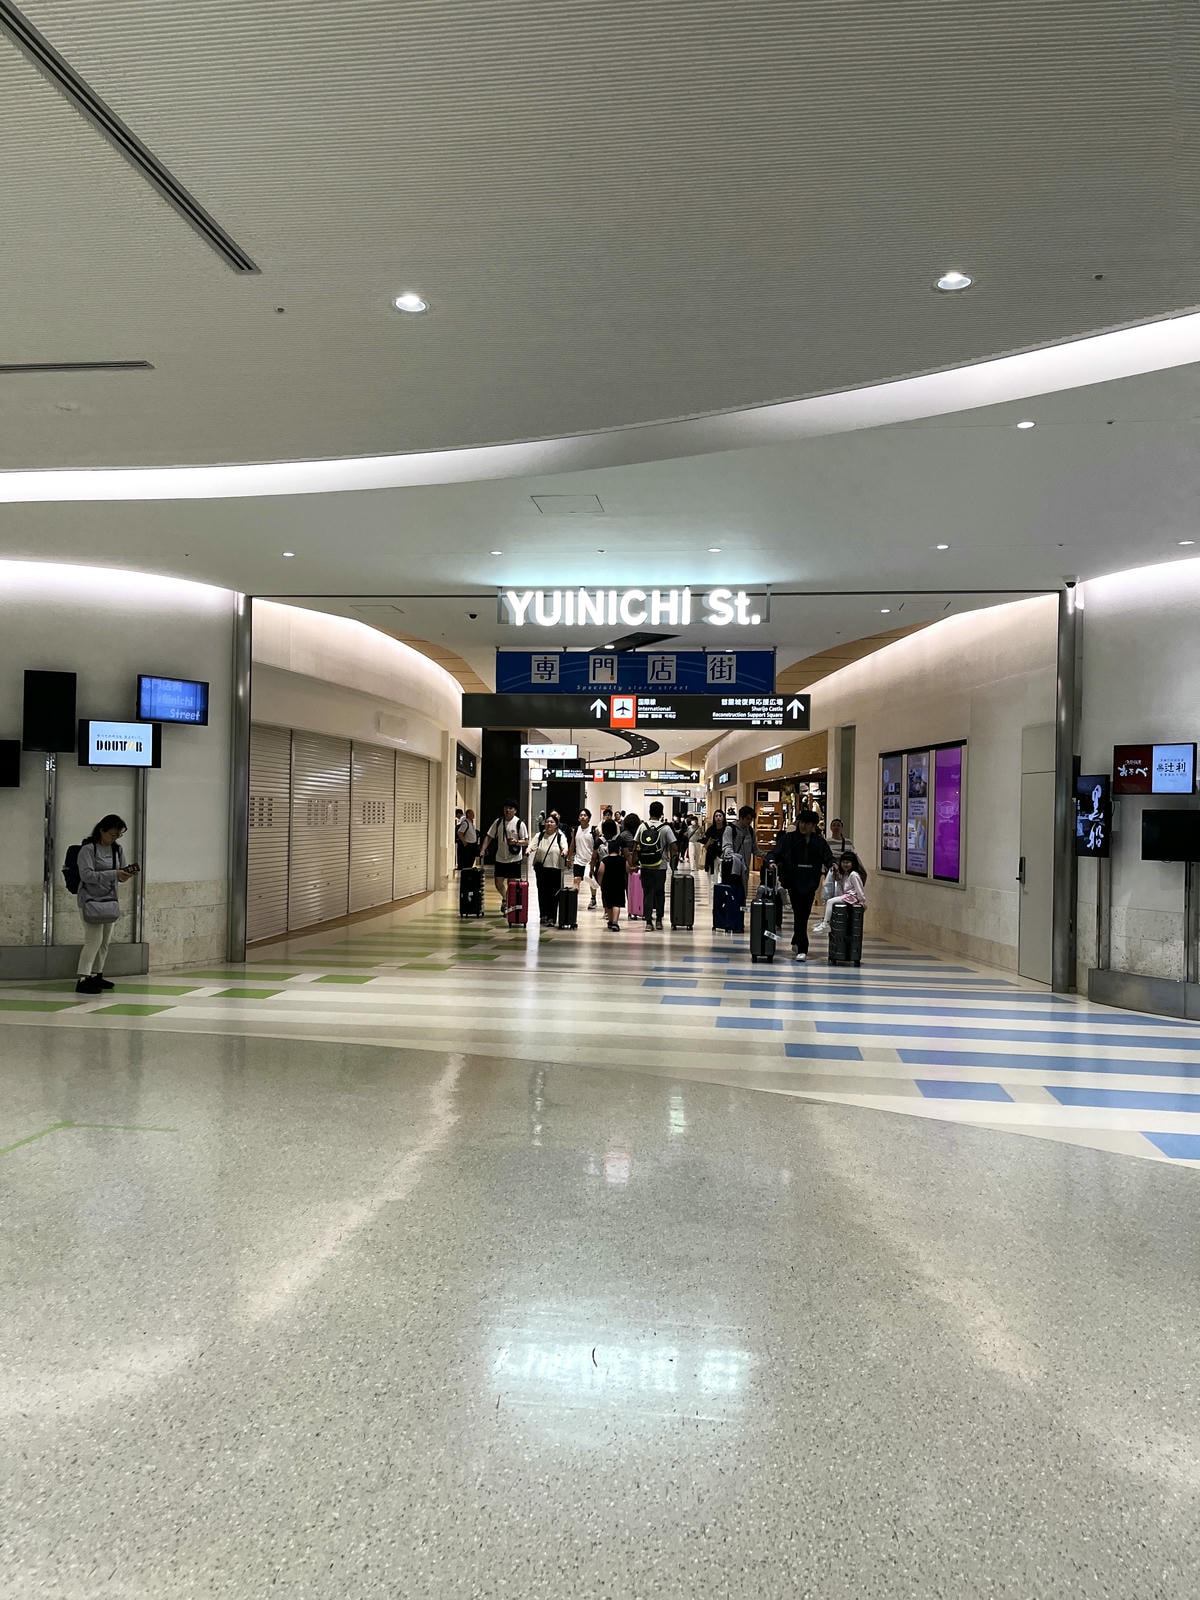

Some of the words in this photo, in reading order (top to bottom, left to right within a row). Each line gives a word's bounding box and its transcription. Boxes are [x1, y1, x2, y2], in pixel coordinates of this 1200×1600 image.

[506, 589, 691, 627] YUINICHI
[707, 588, 761, 627] St.
[531, 655, 736, 682] 専門店街
[169, 708, 200, 720] Street
